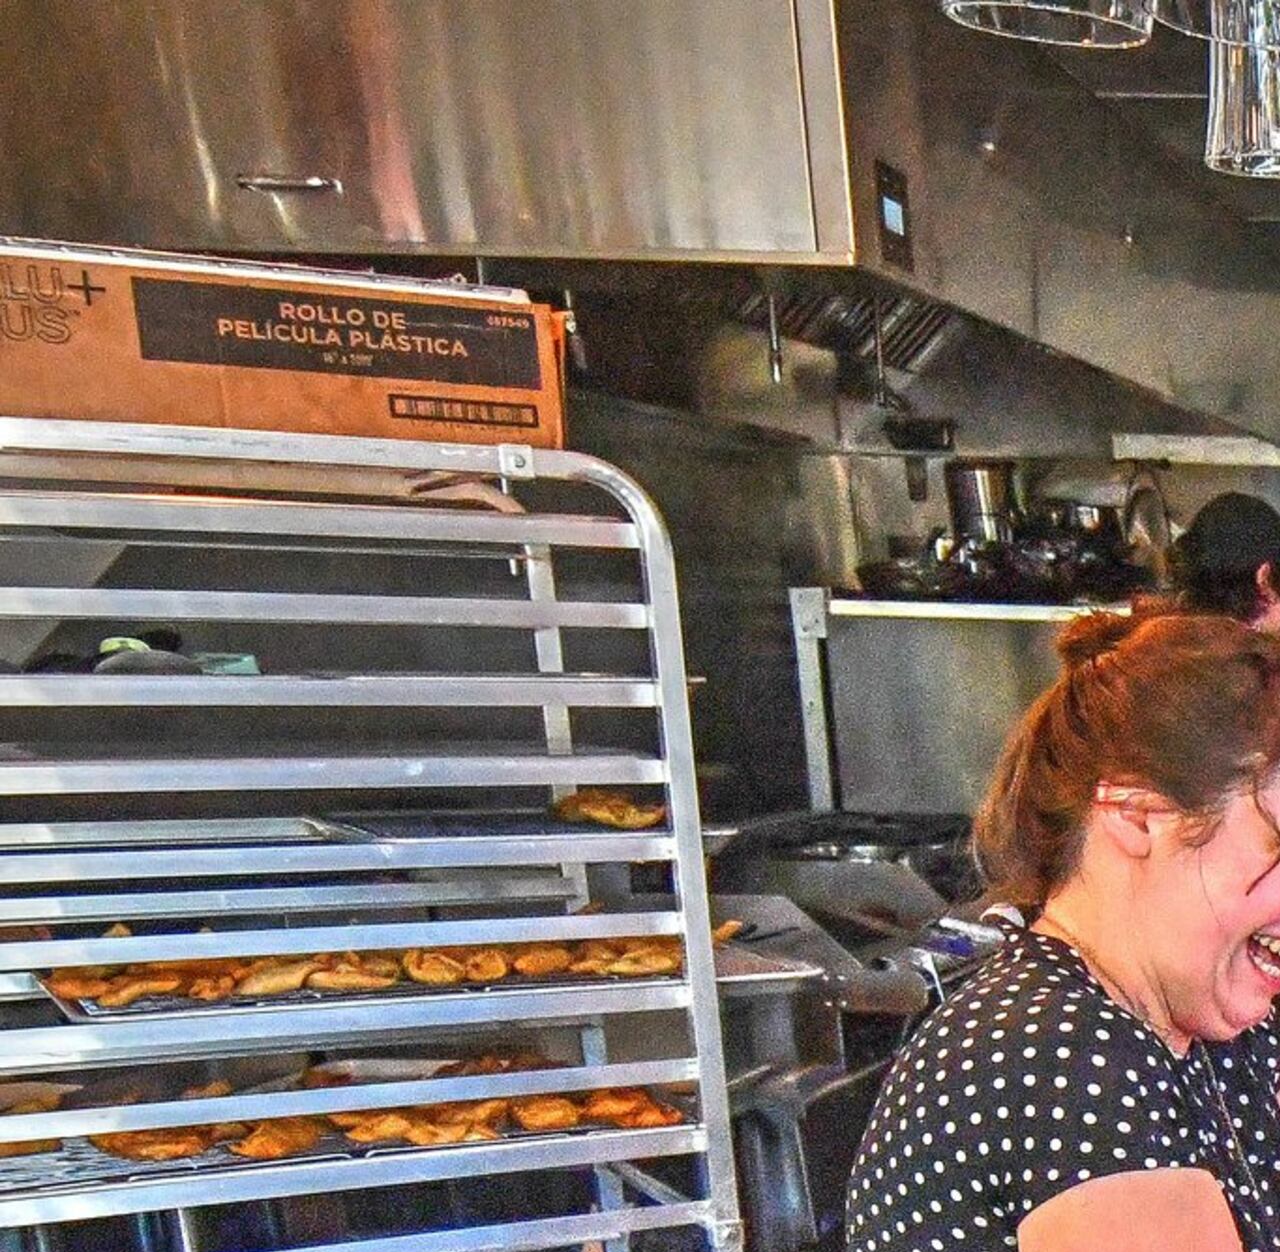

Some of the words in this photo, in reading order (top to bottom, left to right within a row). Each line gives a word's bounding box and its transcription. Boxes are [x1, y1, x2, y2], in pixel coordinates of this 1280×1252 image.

[279, 302, 366, 326] ROLLO
[372, 310, 407, 331] DE
[216, 318, 343, 347] PELÍCULA
[350, 329, 470, 357] PLÁSTICA
